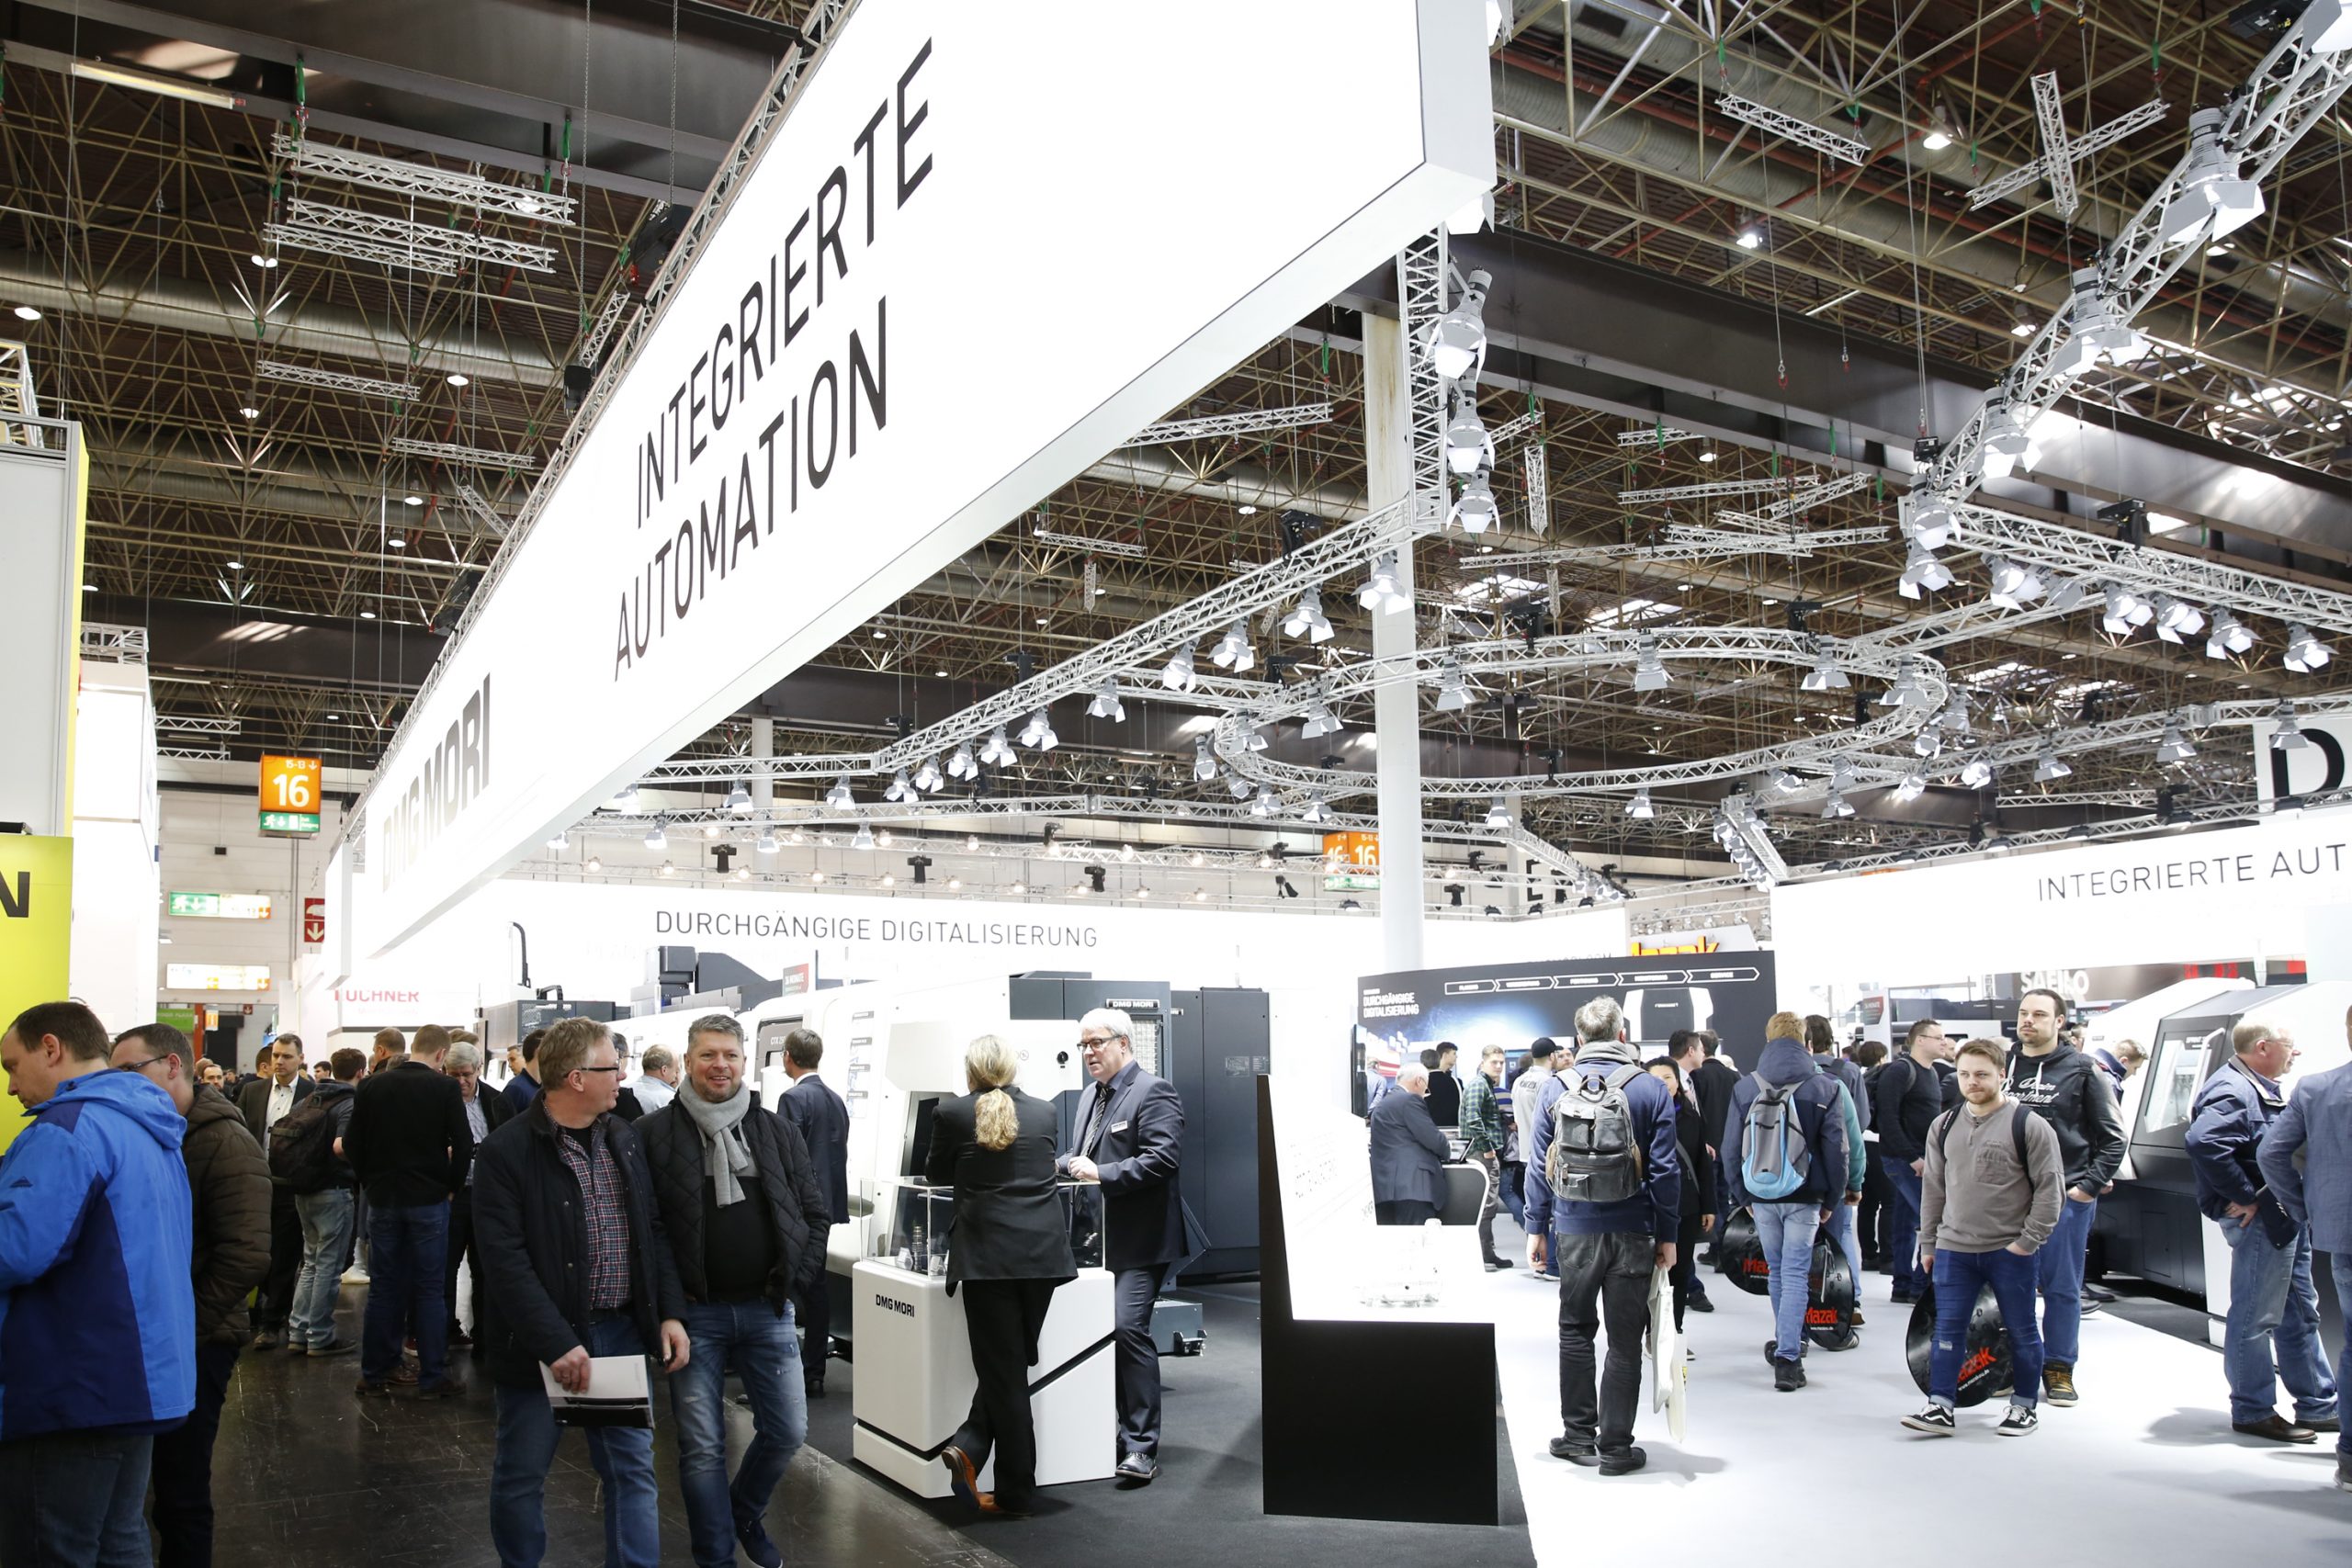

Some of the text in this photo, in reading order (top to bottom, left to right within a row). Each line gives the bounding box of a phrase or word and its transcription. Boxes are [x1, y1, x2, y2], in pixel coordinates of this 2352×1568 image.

[638, 35, 933, 530] INTEGRIERTE
[614, 294, 888, 682] AUTOMATION
[272, 773, 311, 808] 16
[383, 671, 491, 894] DMG MORI
[1354, 844, 1377, 866] 16
[2039, 843, 2346, 901] INTEGRIERTE AUT
[655, 909, 1098, 948] DURCHGÄNGIGE DIGITALISIERUNG
[876, 1293, 915, 1318] DMG MORI
[1957, 1347, 1997, 1383] azak
